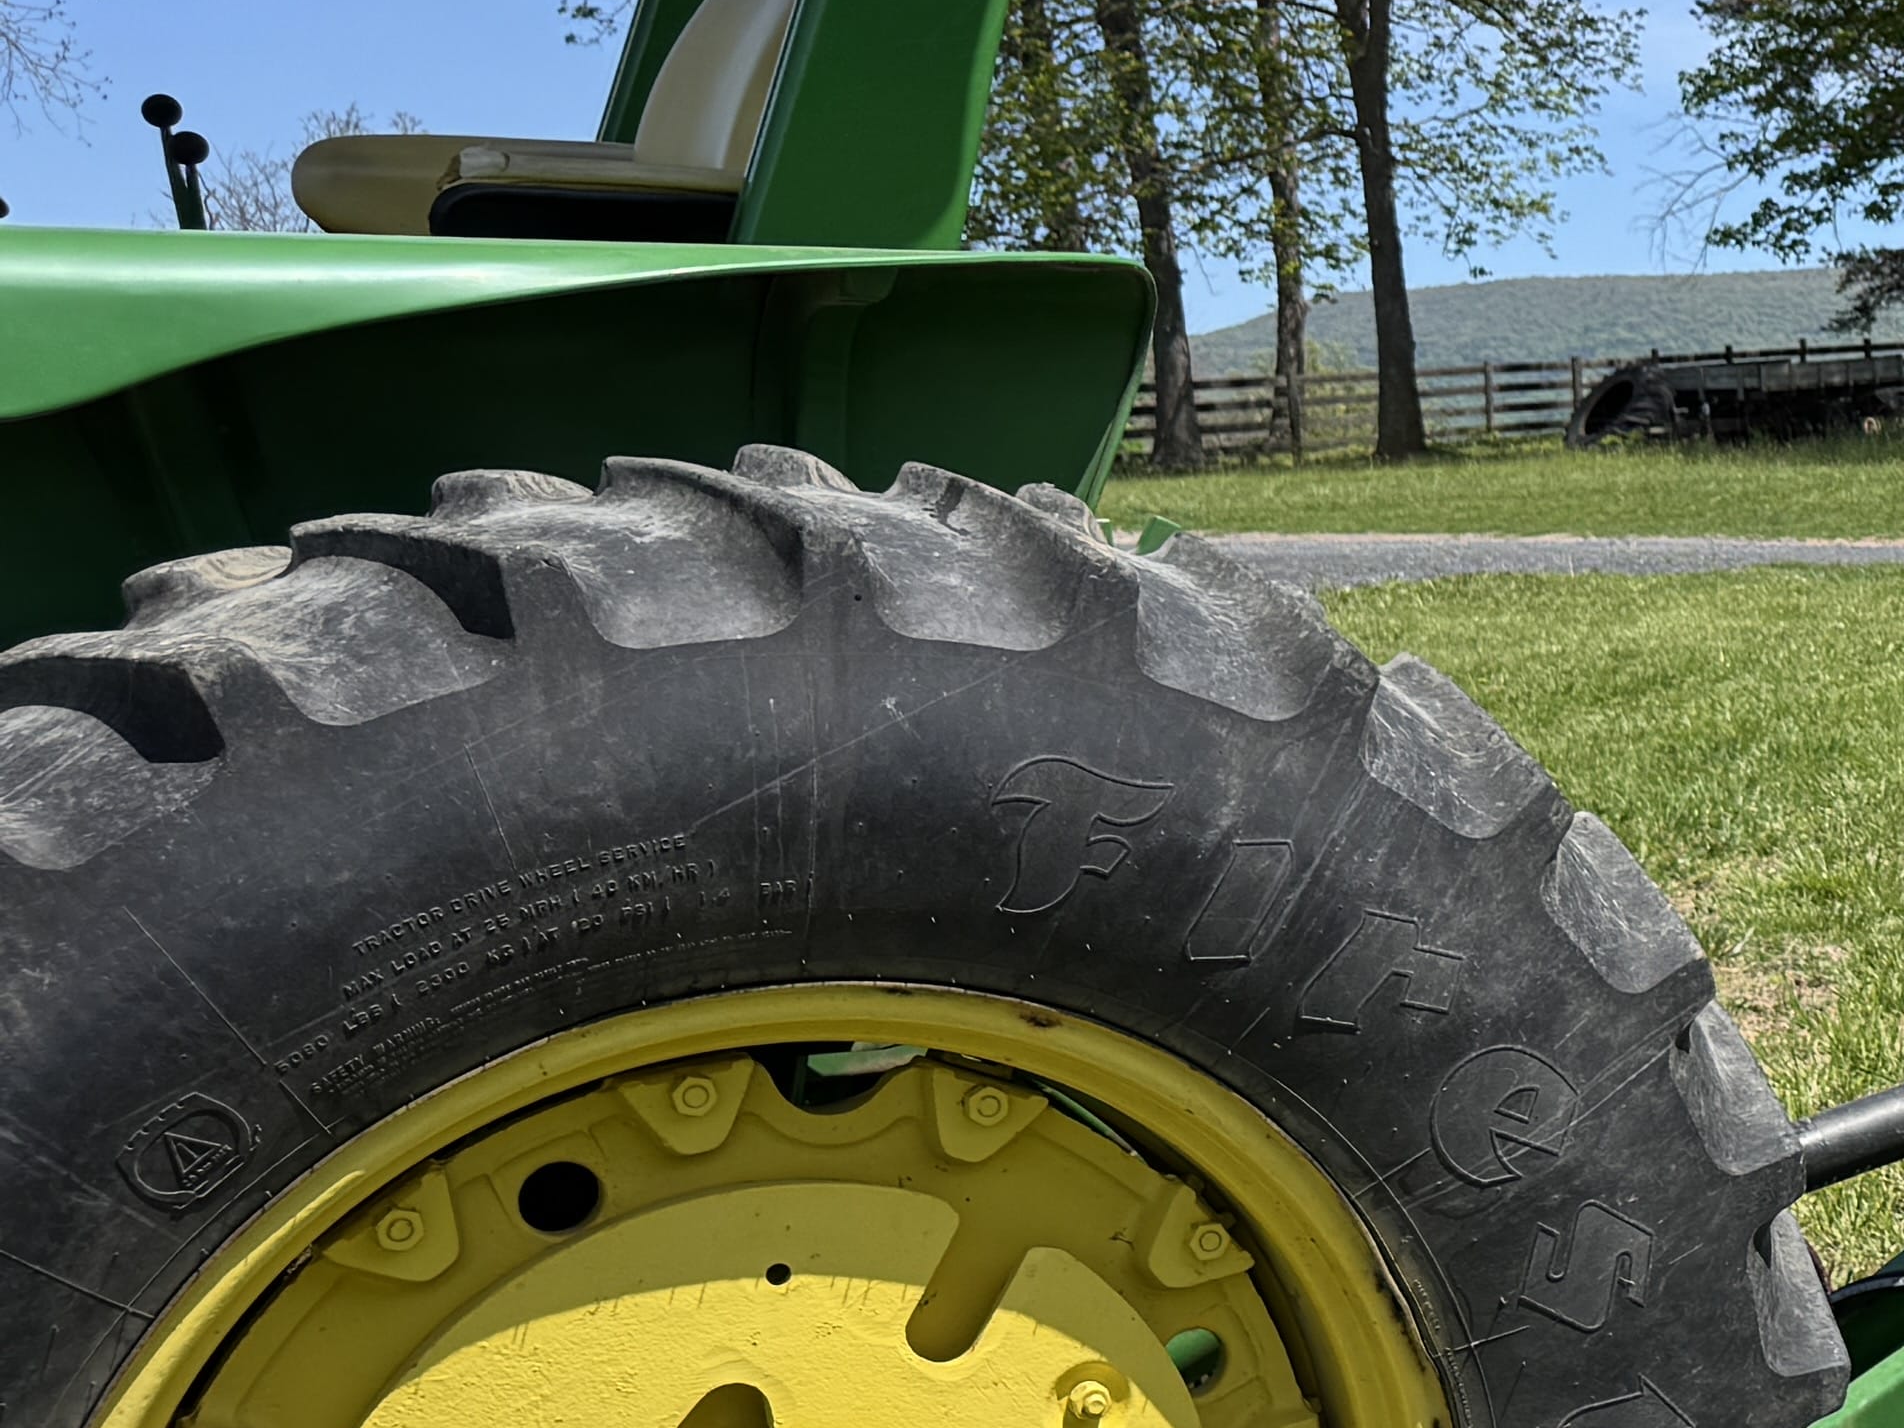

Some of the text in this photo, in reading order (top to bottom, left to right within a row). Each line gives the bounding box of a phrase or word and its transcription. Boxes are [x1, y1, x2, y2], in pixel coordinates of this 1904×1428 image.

[352, 834, 686, 957] TRACTOR DRIVE WHEEL SERVICE
[342, 968, 384, 1000] MAX
[391, 941, 442, 973] LOAD
[451, 927, 473, 949] AT
